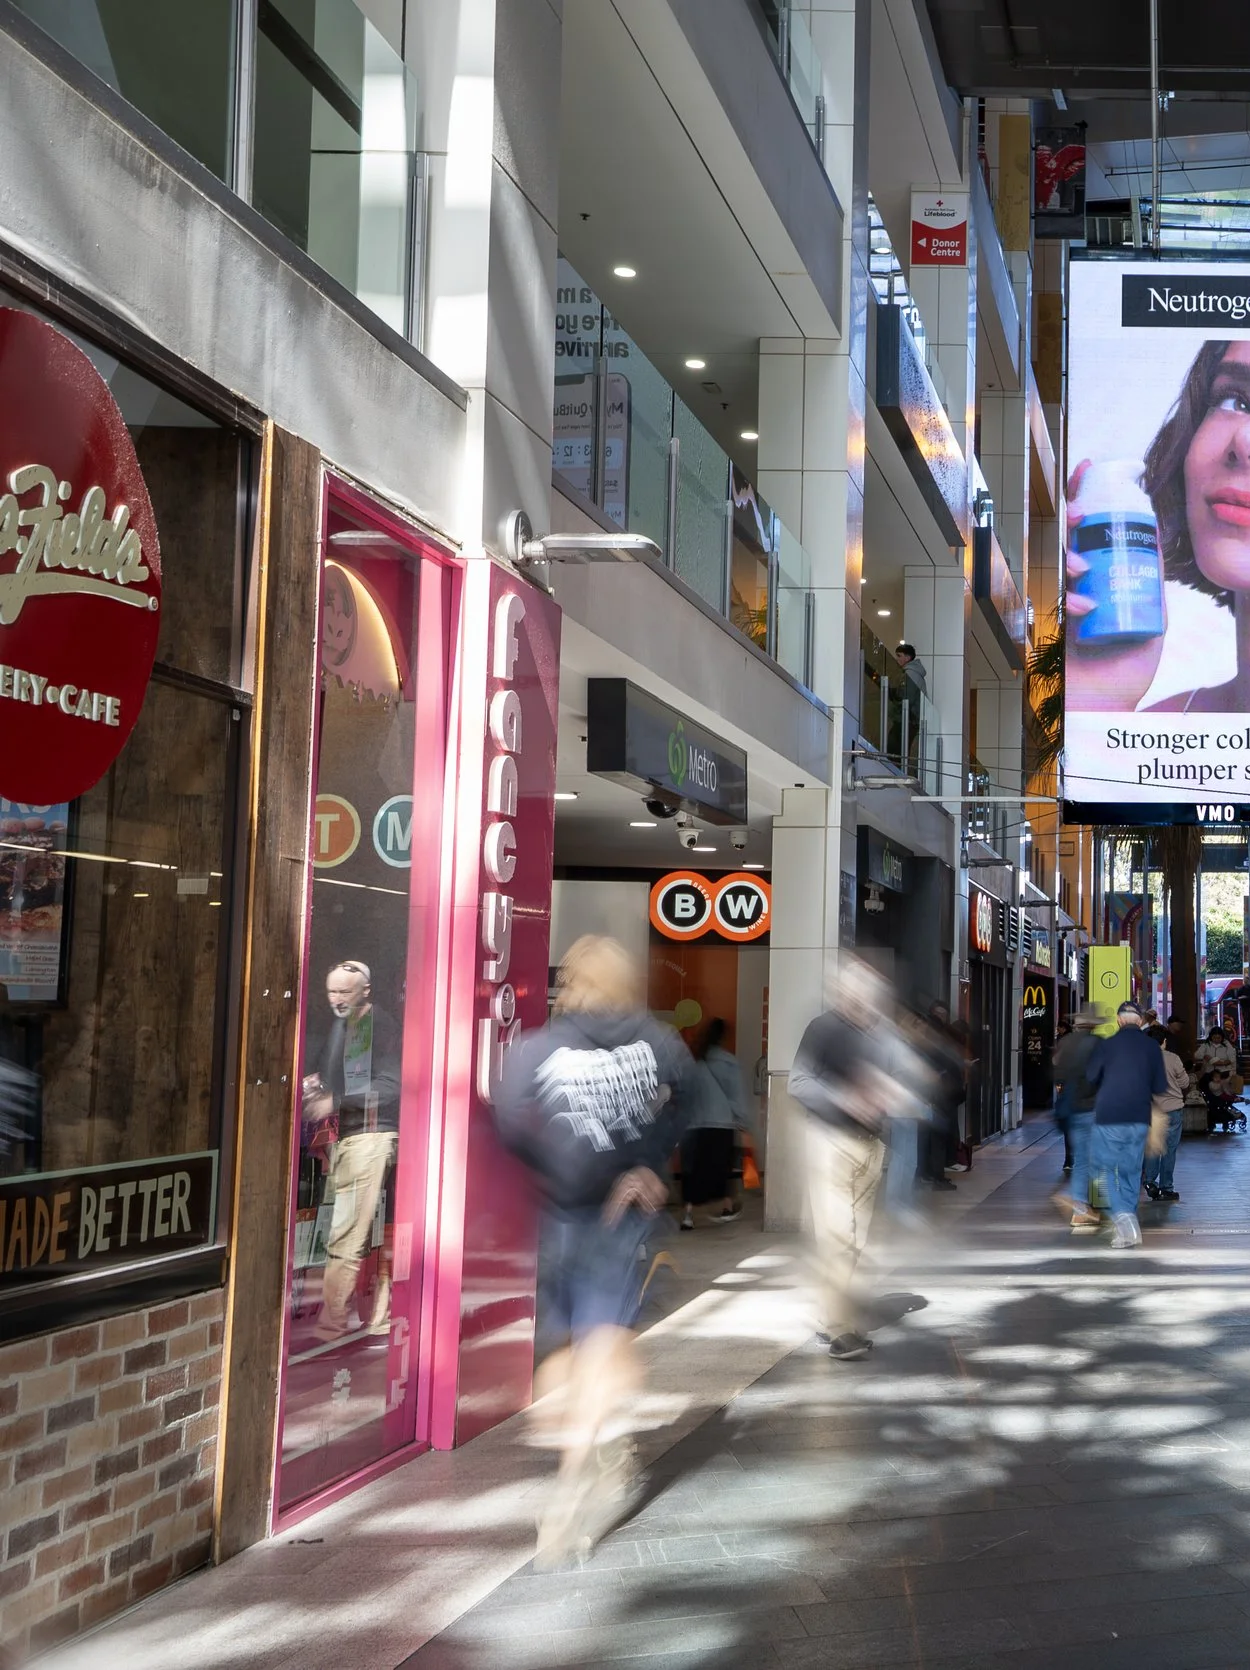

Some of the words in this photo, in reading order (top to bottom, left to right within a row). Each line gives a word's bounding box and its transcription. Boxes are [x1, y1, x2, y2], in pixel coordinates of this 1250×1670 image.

[930, 248, 961, 257] Centre
[932, 238, 960, 248] Donor
[9, 464, 149, 584] Fields
[1106, 728, 1210, 753] Stronger
[688, 744, 717, 792] Metro
[1137, 758, 1238, 785] plumper
[1196, 804, 1235, 822] VMO
[674, 893, 696, 918] B
[725, 894, 759, 919] W
[1027, 1041, 1042, 1050] 24
[0, 1191, 71, 1273] ADE
[77, 1171, 192, 1260] BETTER
